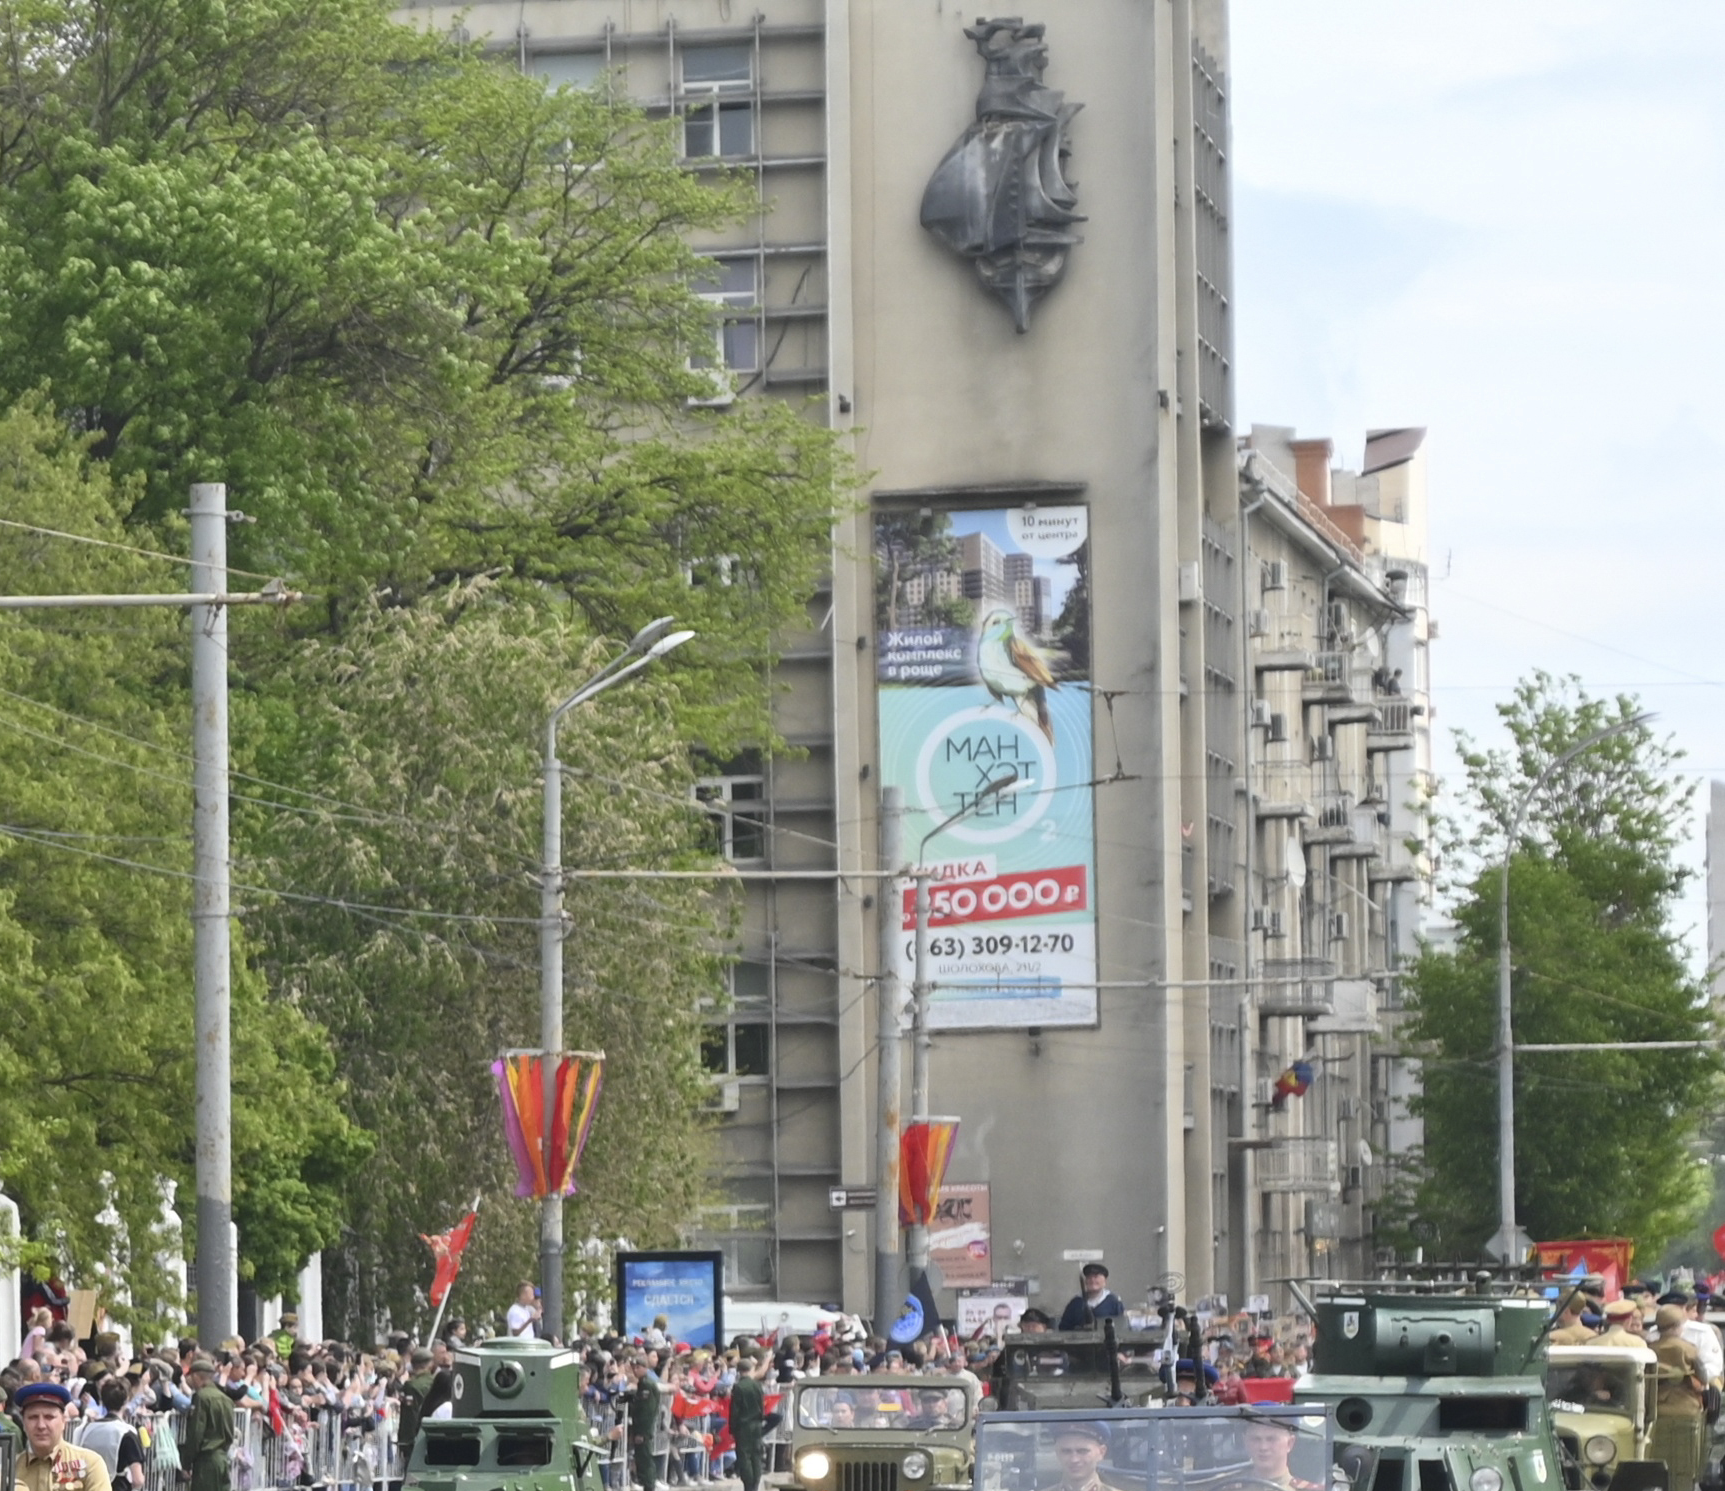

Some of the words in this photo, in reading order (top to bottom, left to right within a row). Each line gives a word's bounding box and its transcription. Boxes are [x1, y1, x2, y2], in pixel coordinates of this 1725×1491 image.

[1022, 515, 1035, 526] 10
[1038, 516, 1079, 530] минут
[887, 630, 943, 646] Жилой
[887, 647, 962, 661] комплекс
[888, 667, 896, 676] в
[901, 664, 943, 679] роще
[946, 734, 1018, 762] МАН
[1041, 820, 1057, 841] 2
[982, 878, 1060, 913] 000
[905, 936, 966, 962] (63)
[972, 933, 1074, 955] 309-12-70
